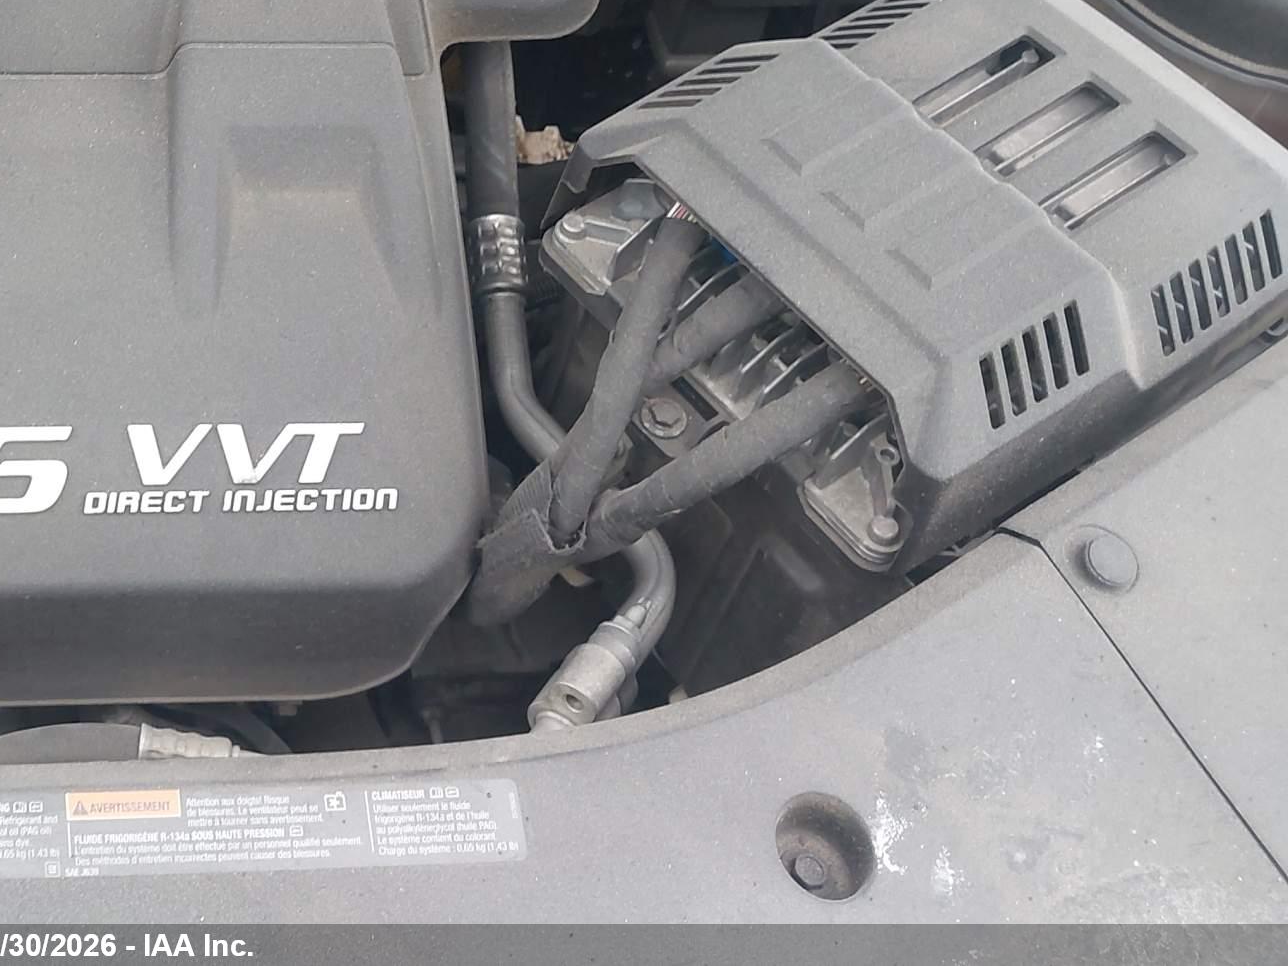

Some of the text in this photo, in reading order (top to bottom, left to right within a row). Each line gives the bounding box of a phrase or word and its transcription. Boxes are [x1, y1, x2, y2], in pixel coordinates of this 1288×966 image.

[126, 422, 365, 486] VVT
[82, 487, 399, 516] DIRECT INJECTION
[371, 789, 425, 800] CLIMATISEUR
[90, 801, 170, 813] AVERTISSEMENT
[186, 795, 290, 807] Attention aux doigts! Risque
[400, 802, 439, 812] seulement
[187, 804, 318, 817] de blessures. Le ventilateur peut se
[446, 811, 454, 822] et
[456, 811, 465, 821] de
[0, 814, 42, 827] Refrigerant
[43, 814, 58, 824] and
[188, 816, 212, 827] mettre
[221, 816, 248, 826] tourner
[250, 816, 268, 825] sans
[376, 825, 386, 834] au
[74, 834, 103, 845] FLUIDE
[160, 830, 190, 842] R-134a
[192, 830, 212, 841] SOUS
[216, 830, 243, 840] HAUTE
[244, 828, 285, 838] PRESSION
[378, 836, 388, 846] Le
[422, 834, 452, 844] contient
[454, 833, 464, 843] du
[116, 844, 127, 854] du
[162, 842, 177, 852] doit
[228, 840, 242, 851] par
[244, 840, 252, 849] un
[254, 838, 292, 850] personnel
[378, 846, 406, 857] Charge
[408, 845, 418, 855] du
[476, 842, 486, 854] kg
[16, 848, 26, 860] kg
[75, 856, 90, 866] Des
[174, 852, 216, 863] incorrectes
[218, 850, 249, 862] peuvent
[250, 850, 276, 860] causer
[278, 849, 292, 859] des
[65, 866, 79, 876] SAE
